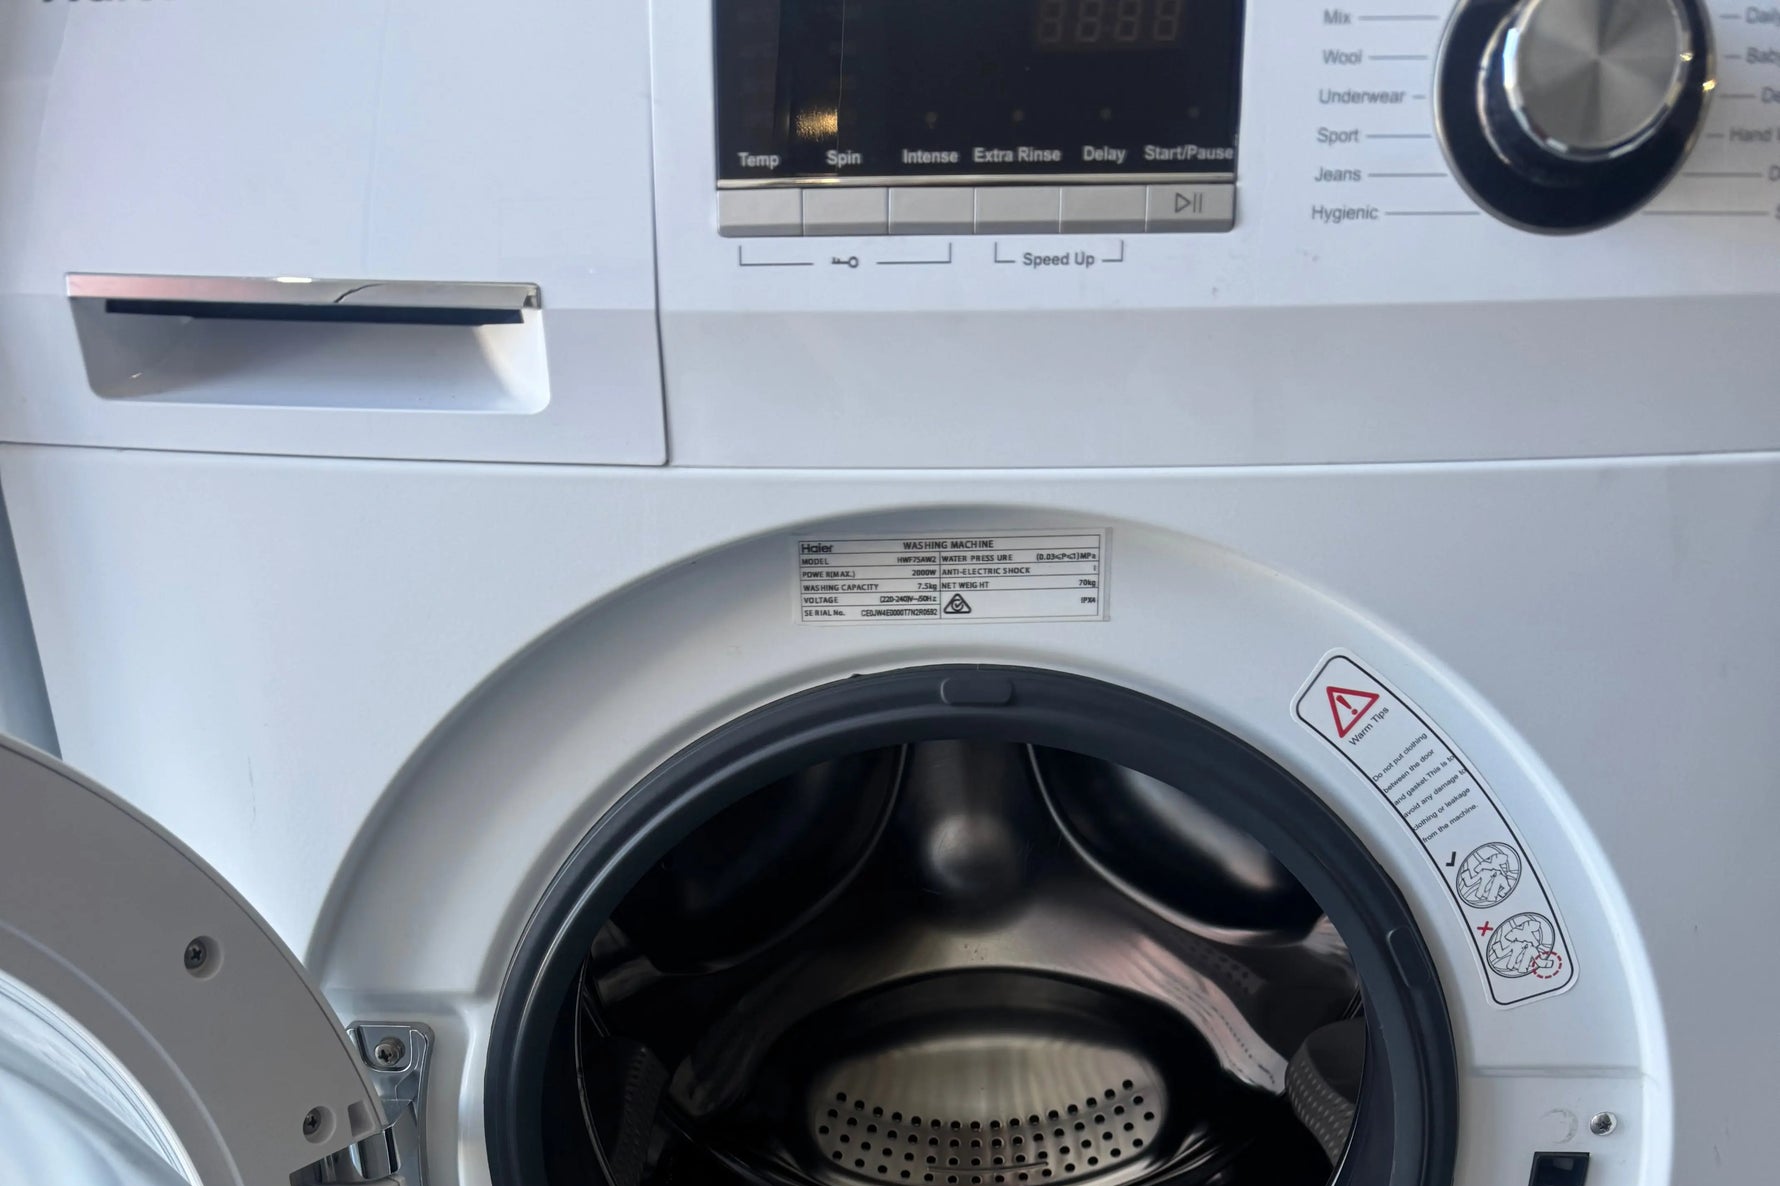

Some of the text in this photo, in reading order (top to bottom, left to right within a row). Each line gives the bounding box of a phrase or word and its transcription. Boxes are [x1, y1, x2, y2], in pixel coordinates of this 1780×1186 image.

[1323, 10, 1351, 25] Mix
[1323, 49, 1363, 65] Wool
[1319, 89, 1405, 104] Underwear
[1317, 128, 1359, 145] Sport
[1729, 127, 1771, 143] Hand
[738, 152, 780, 169] Temp
[826, 150, 861, 167] Spin
[903, 149, 959, 164] Intense
[973, 147, 1061, 163] Extra Rinse
[1083, 146, 1126, 164] Delay
[1144, 145, 1234, 162] Start/Pause
[1314, 167, 1361, 182] Jeans
[1311, 205, 1379, 223] Hygienic
[1023, 252, 1095, 269] Speed Up
[801, 543, 834, 553] Haier
[903, 540, 994, 550] WASHING MACHINE
[917, 582, 937, 591] 7.5kg
[1079, 579, 1096, 587] 70kg
[804, 596, 838, 604] VOLTAGE
[804, 609, 832, 617] SERIAL
[1349, 707, 1389, 746] Warm Tips
[1372, 733, 1428, 782] Do not put clothing
[1383, 749, 1435, 794] between the door
[1394, 793, 1407, 806] and
[1426, 766, 1441, 778] This
[1404, 802, 1421, 818] avoid
[1421, 793, 1433, 806] any
[1434, 774, 1459, 795] damage
[1413, 787, 1470, 831] clothing or leakage
[1422, 830, 1438, 843] from
[1437, 822, 1449, 832] the
